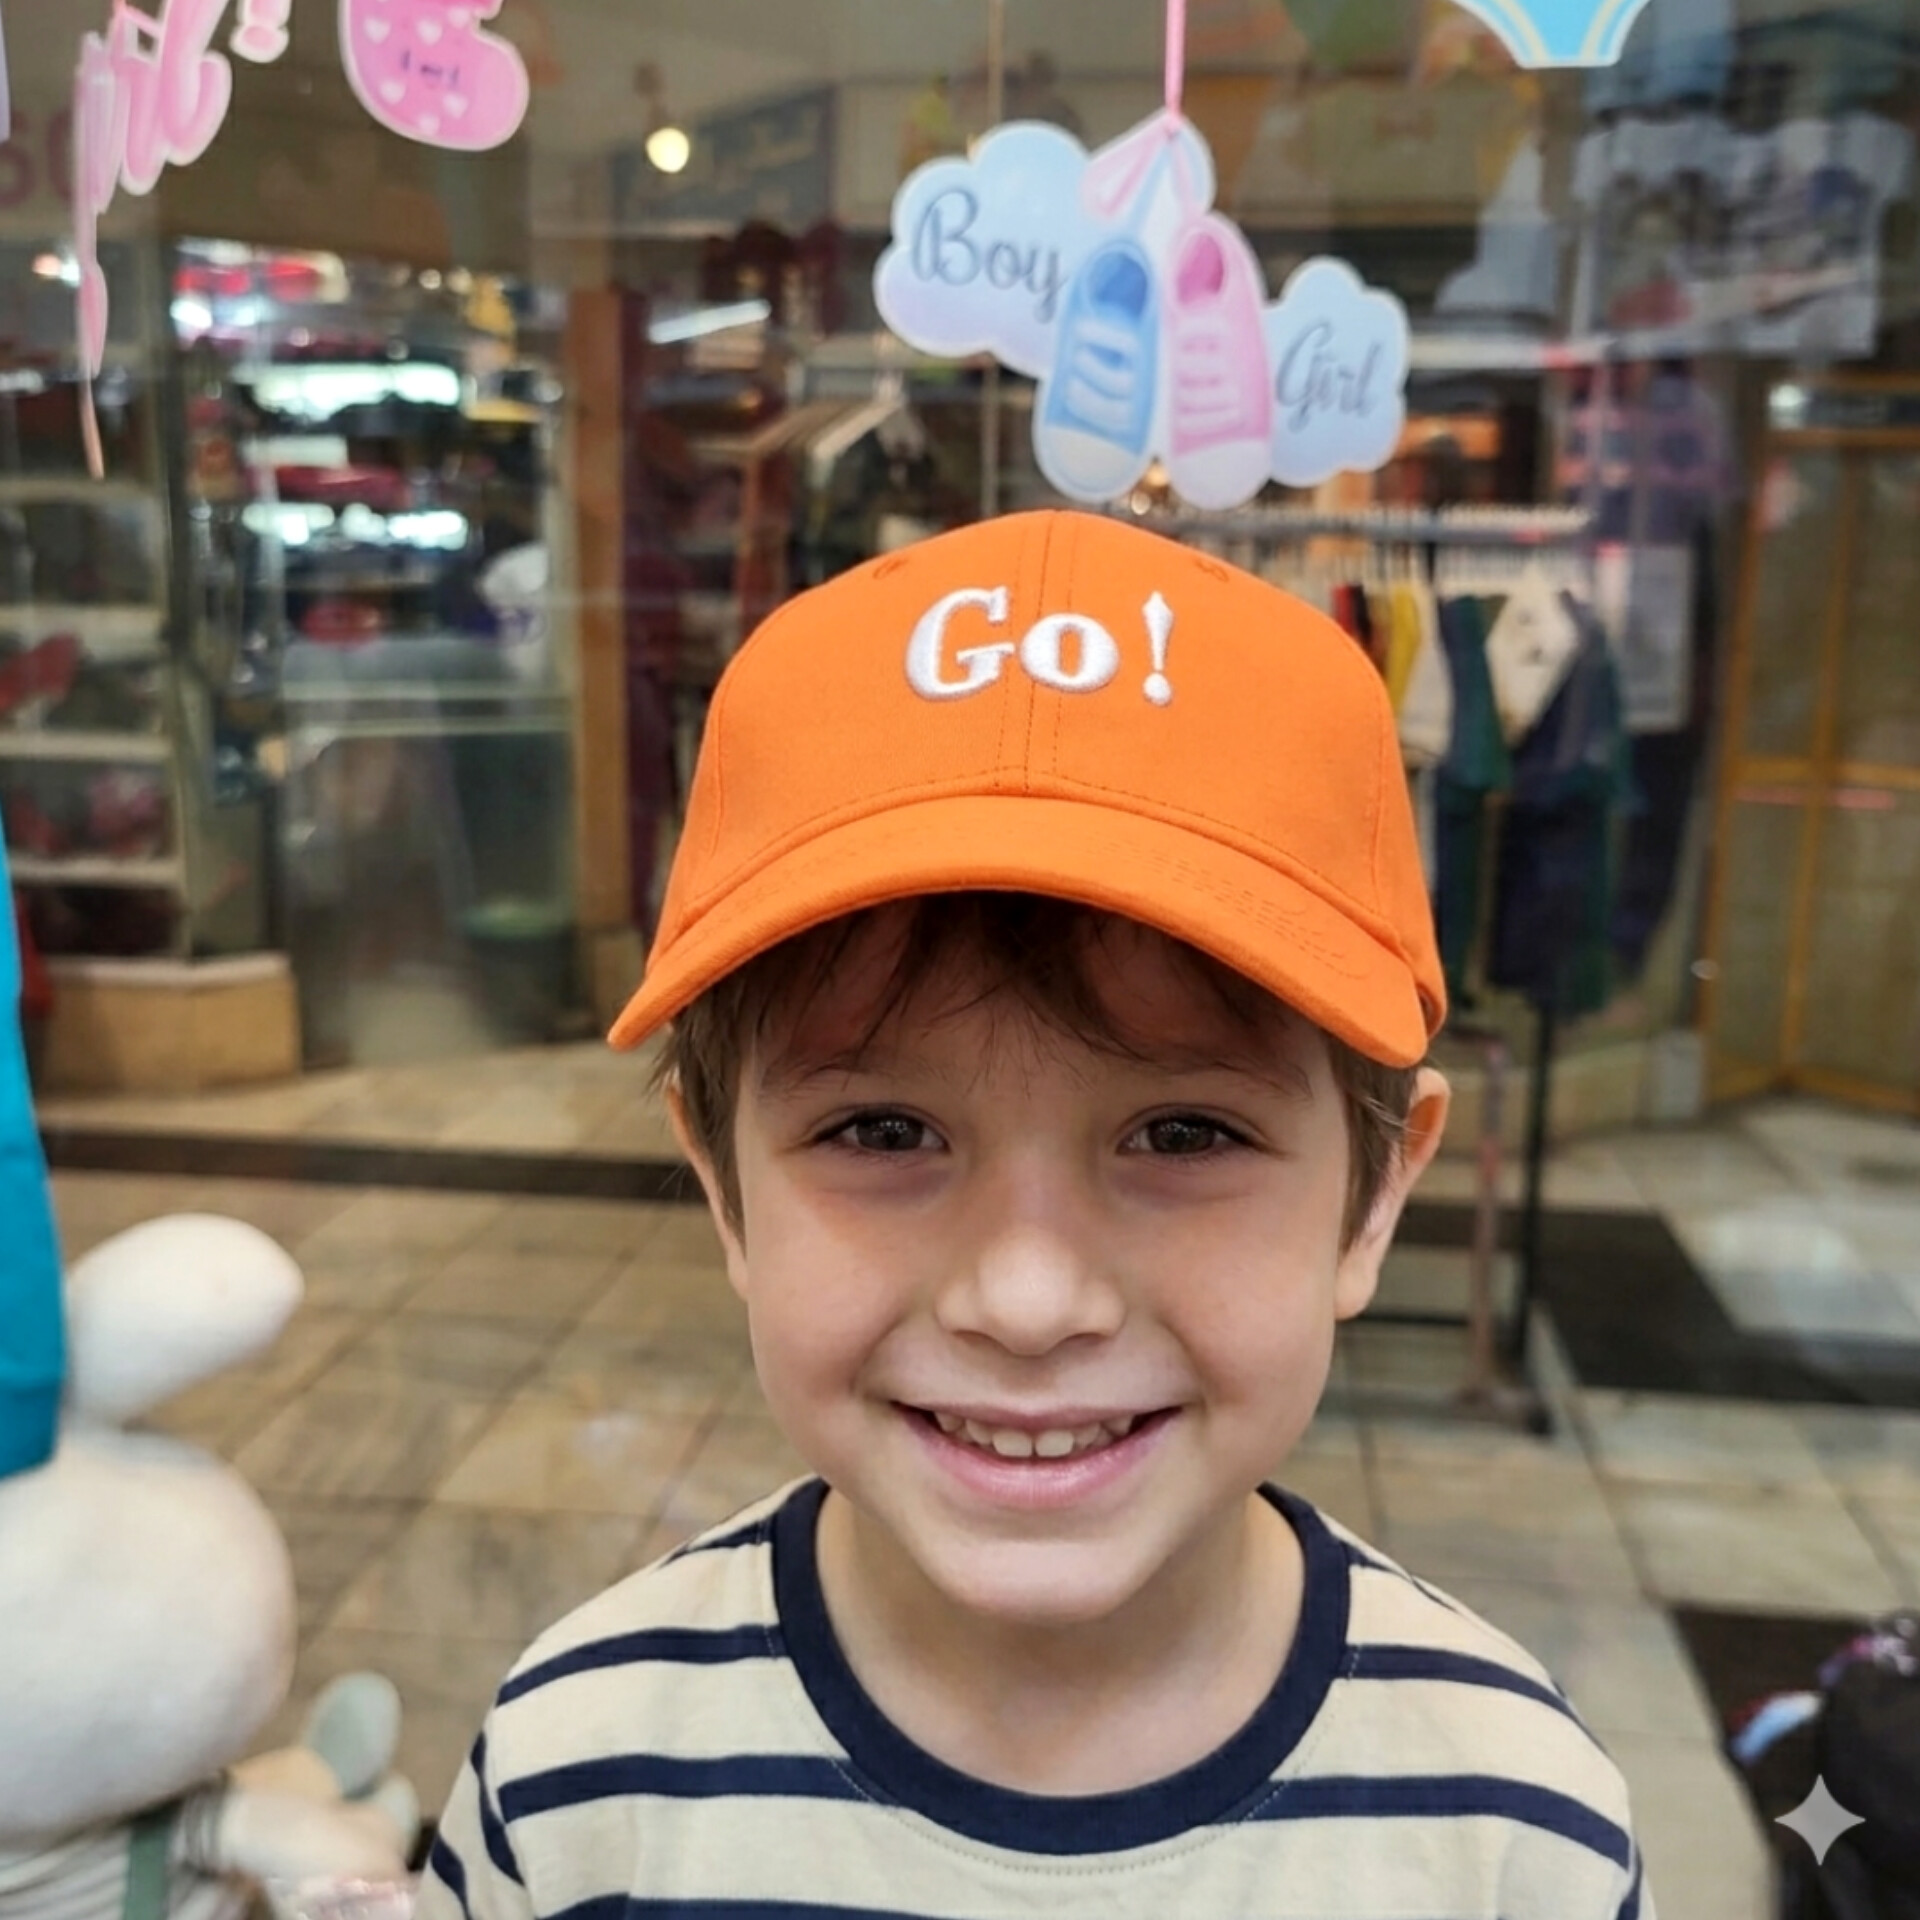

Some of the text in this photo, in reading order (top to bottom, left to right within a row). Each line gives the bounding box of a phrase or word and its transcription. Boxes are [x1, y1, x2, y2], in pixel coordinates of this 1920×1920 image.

[911, 187, 1069, 324] Boy
[1276, 321, 1381, 434] Girl
[904, 585, 1174, 707] Go!
